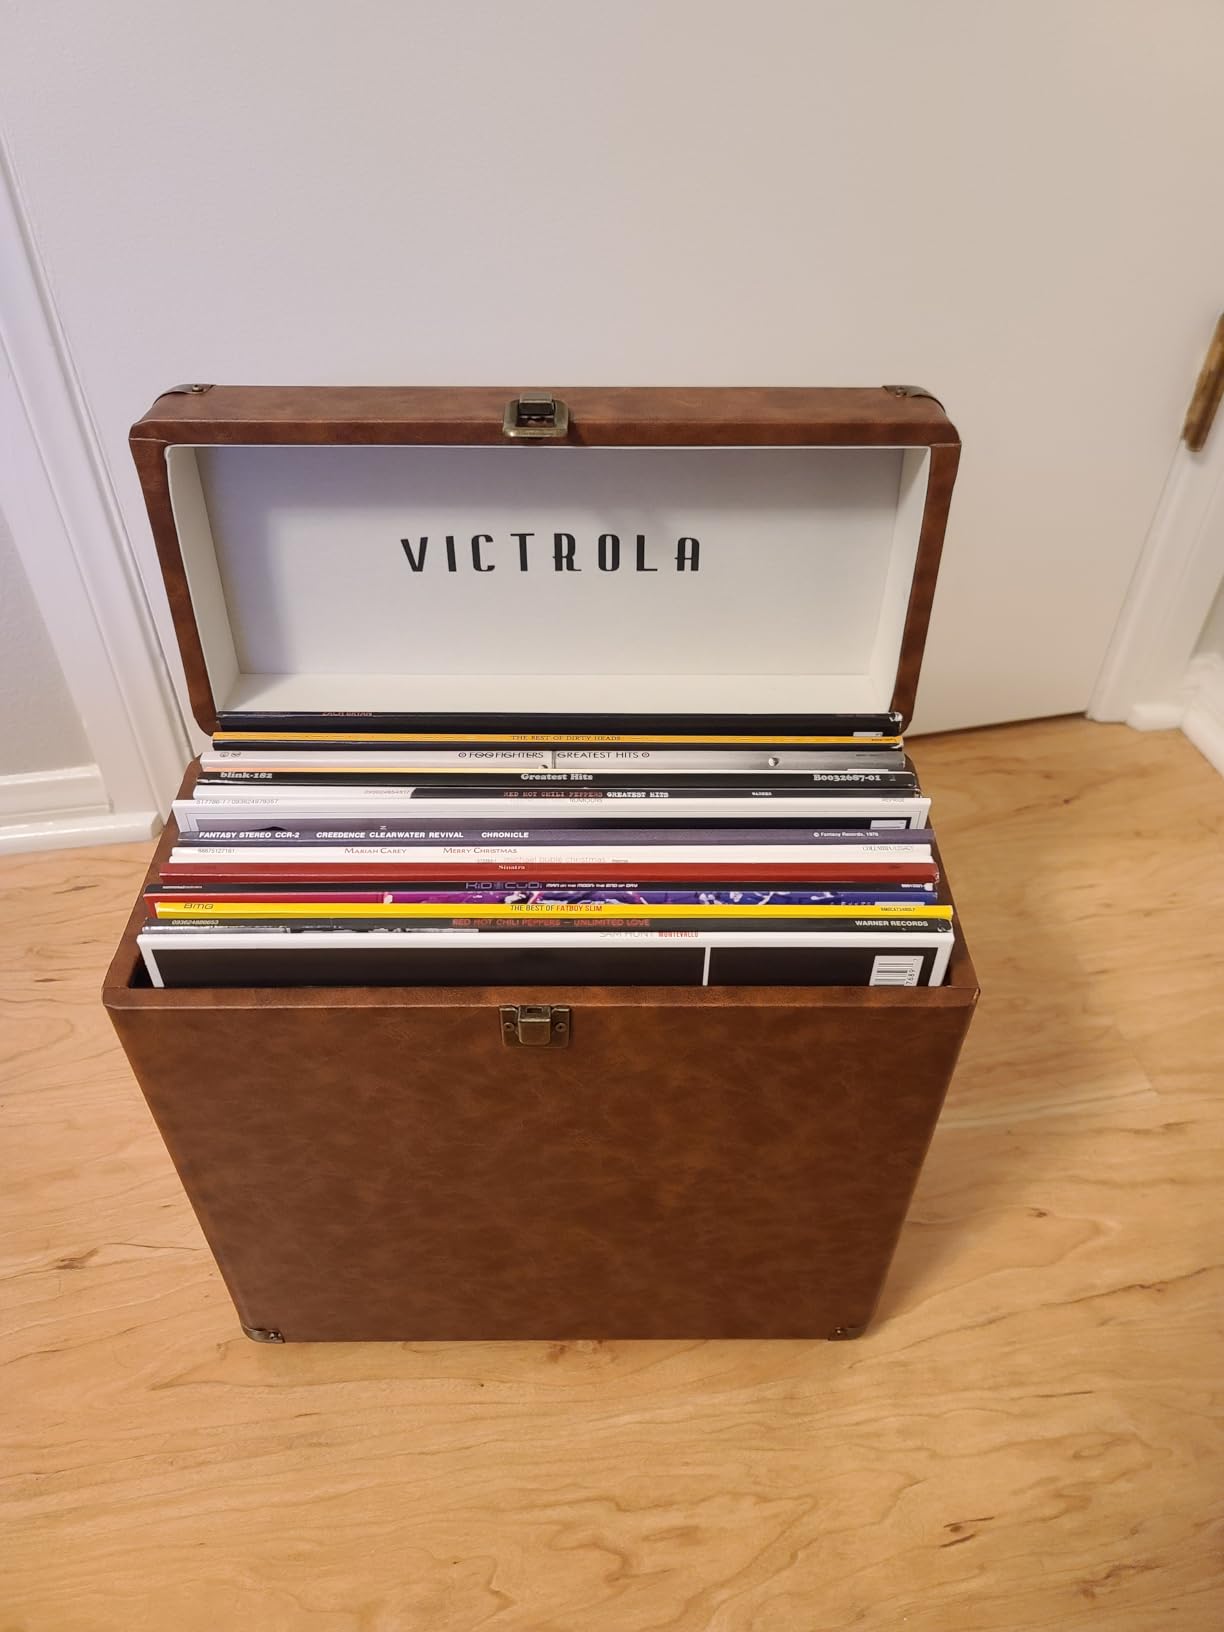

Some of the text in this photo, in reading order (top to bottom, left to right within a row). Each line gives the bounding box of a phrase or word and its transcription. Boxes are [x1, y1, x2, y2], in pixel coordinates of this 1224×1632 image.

[400, 533, 700, 572] VICTROLA
[520, 773, 568, 781] Greatest
[570, 773, 593, 781] Hits
[813, 774, 881, 782] B0032687-01
[585, 904, 603, 912] SLIM
[626, 918, 650, 926] LOVE
